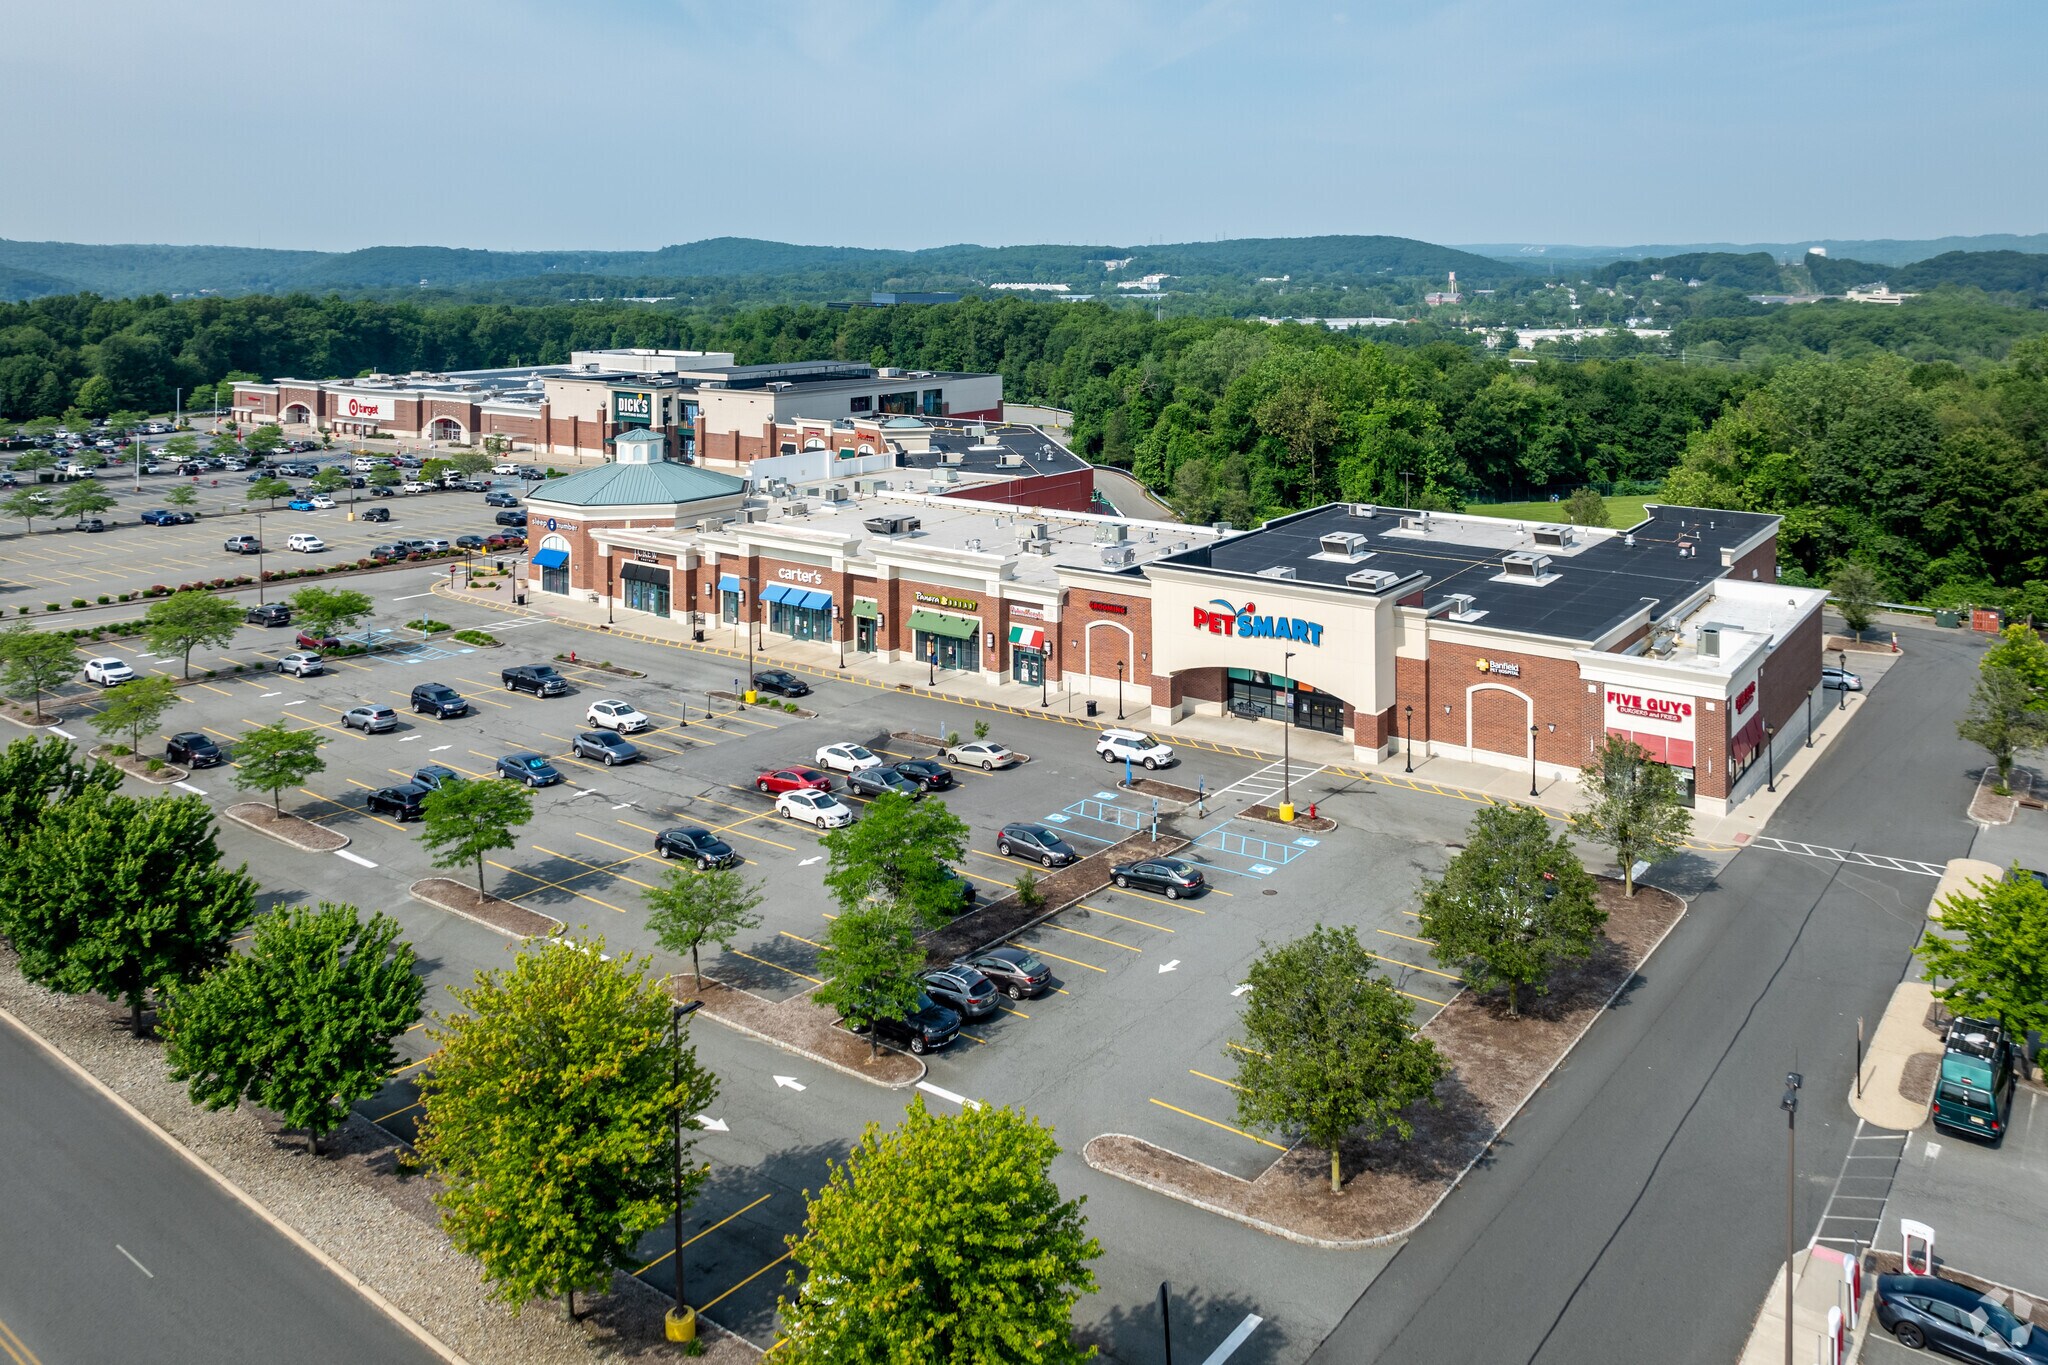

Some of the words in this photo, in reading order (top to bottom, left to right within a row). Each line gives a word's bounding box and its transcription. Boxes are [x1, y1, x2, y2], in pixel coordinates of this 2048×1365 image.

[359, 403, 378, 416] target
[618, 397, 648, 413] DICK'S
[531, 517, 547, 528] sleep
[556, 522, 578, 531] number
[778, 567, 822, 585] carter's
[1089, 601, 1126, 615] GROOMING
[1490, 660, 1519, 672] Banfield
[1607, 691, 1642, 709] FIVE
[1647, 697, 1692, 717] GUYS
[1620, 706, 1649, 717] BURGERS
[1660, 713, 1678, 721] FRIES
